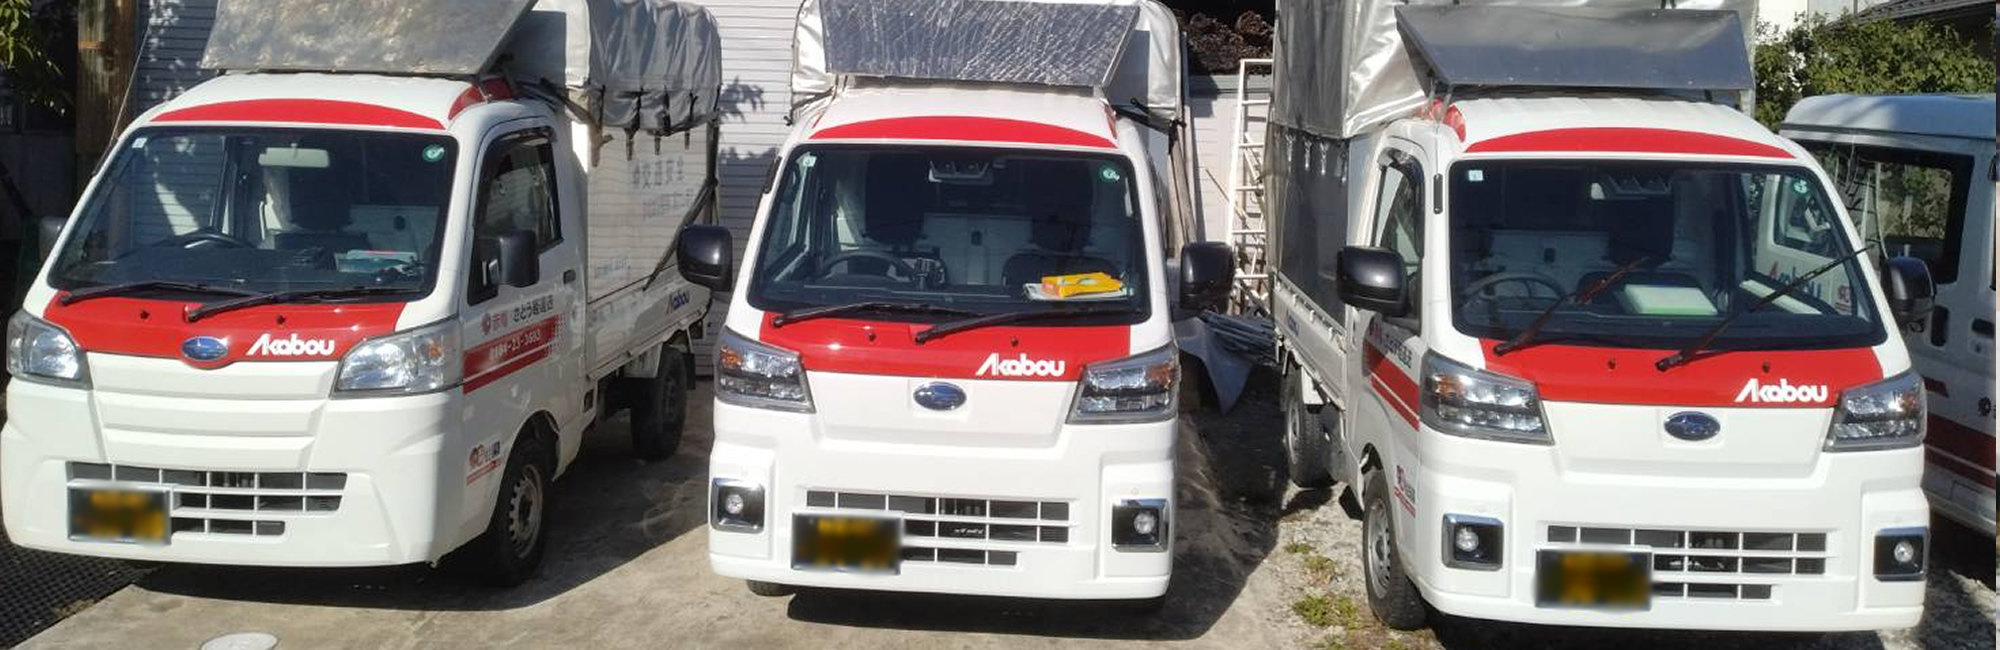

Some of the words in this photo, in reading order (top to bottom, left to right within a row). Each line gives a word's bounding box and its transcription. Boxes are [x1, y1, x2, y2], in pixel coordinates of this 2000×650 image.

[245, 333, 335, 356] Akabou
[975, 352, 1065, 376] Akabou
[1734, 378, 1828, 402] Akabou
